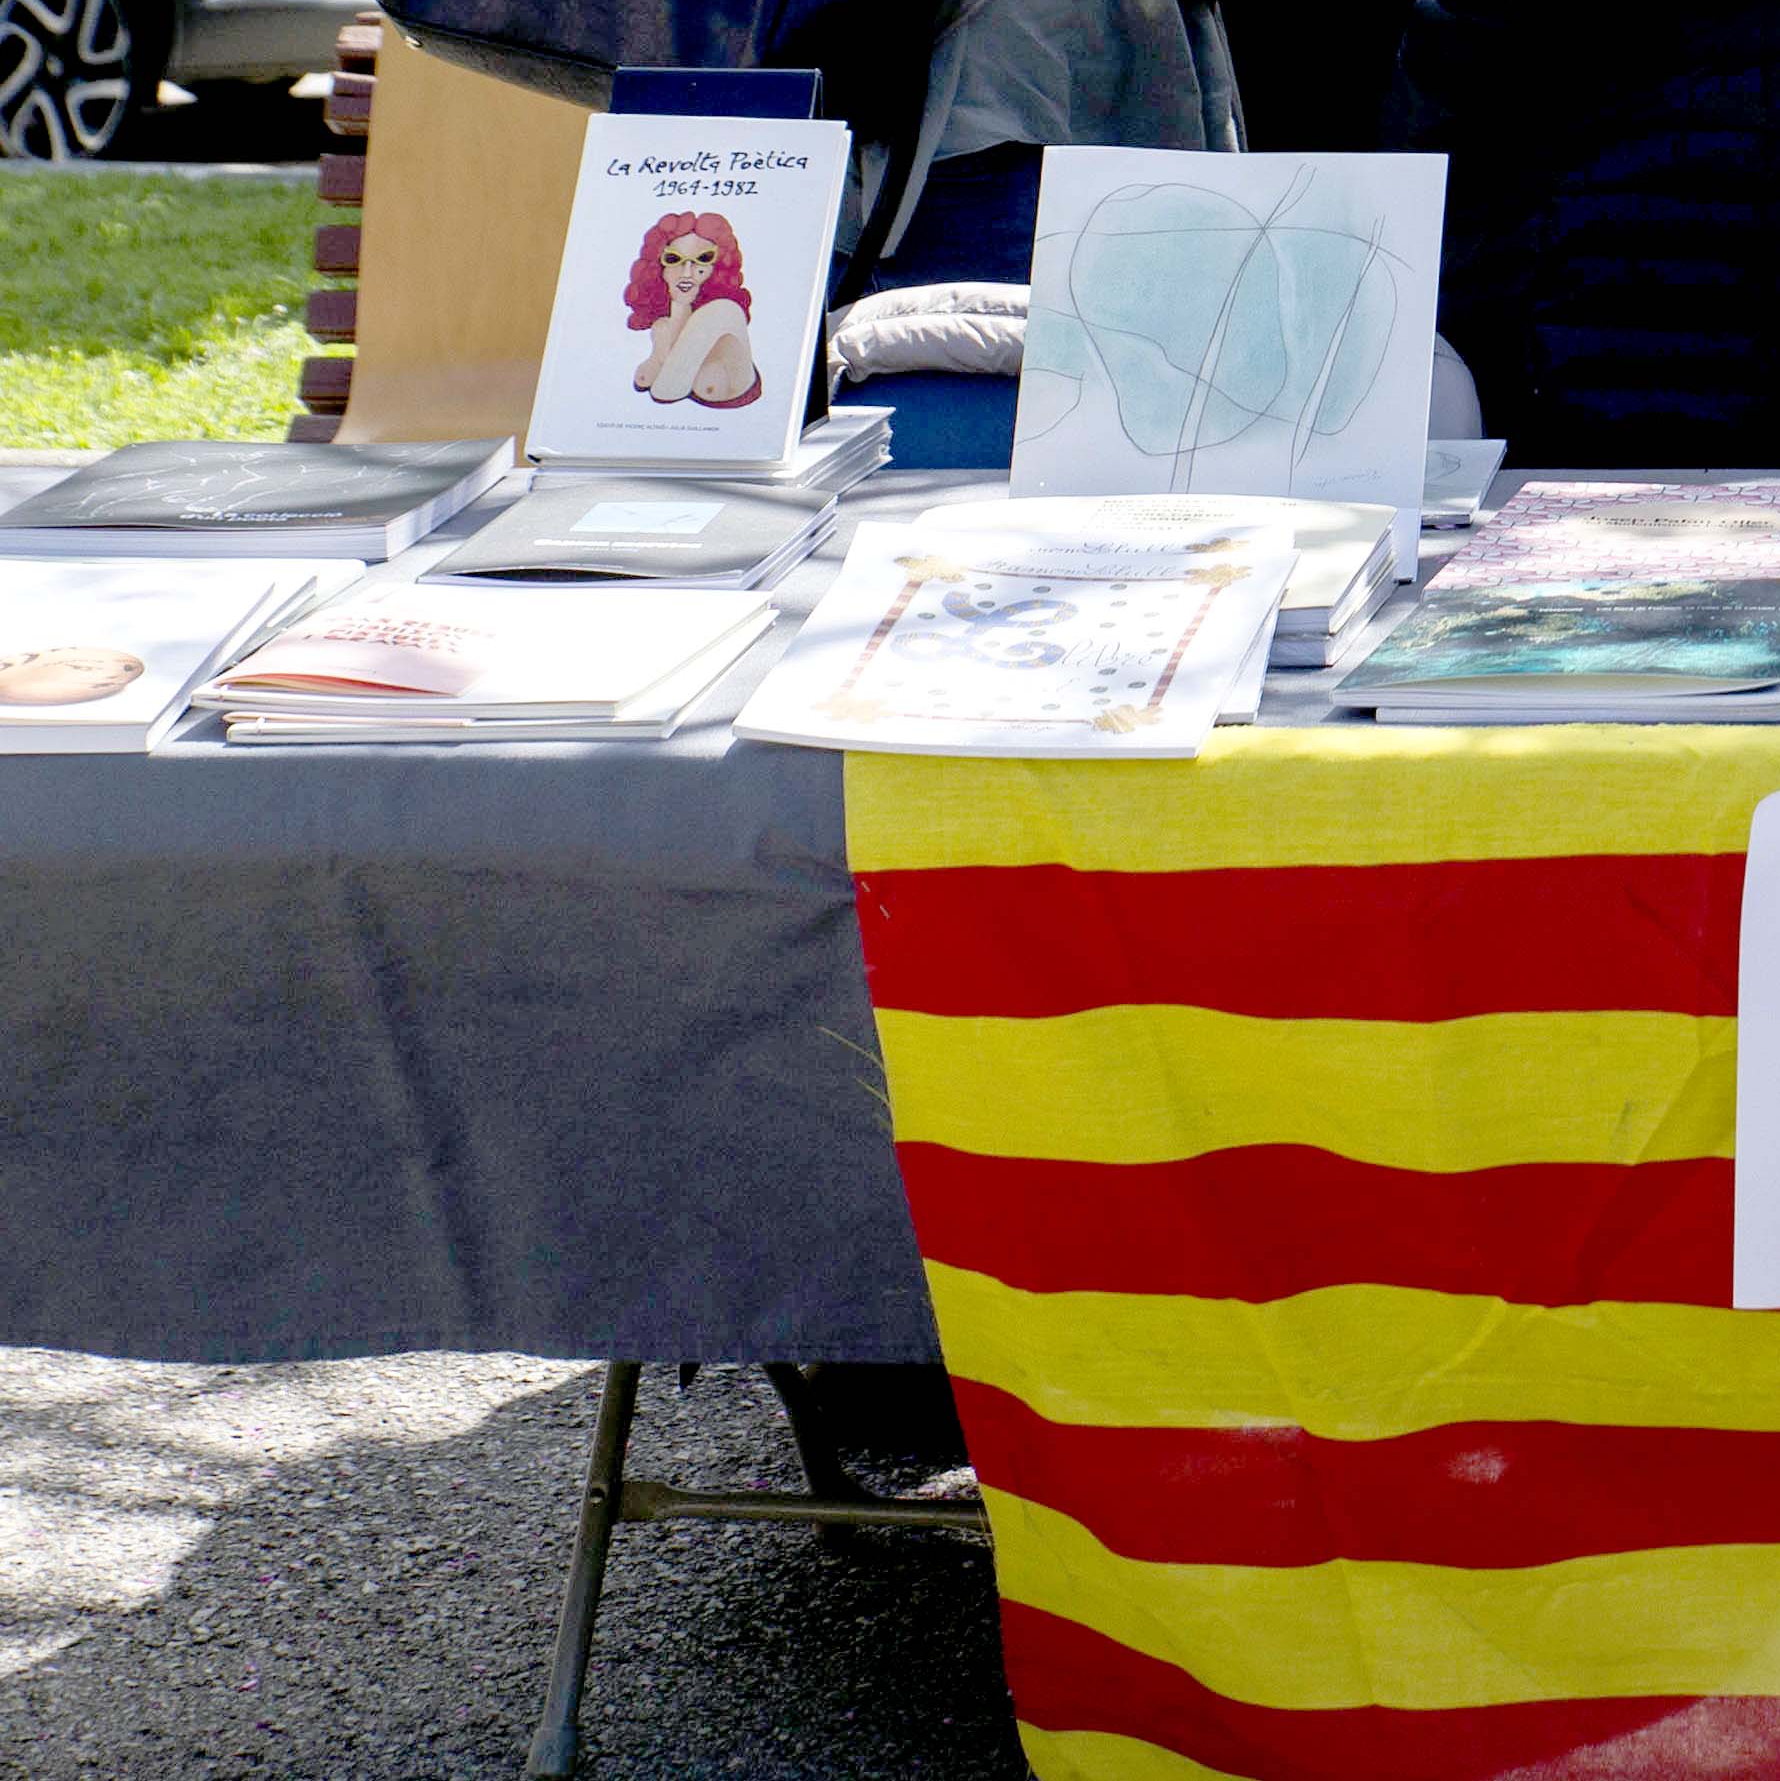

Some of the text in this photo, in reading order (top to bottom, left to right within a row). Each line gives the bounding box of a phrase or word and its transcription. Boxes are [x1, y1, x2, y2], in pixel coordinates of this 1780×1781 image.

[607, 150, 808, 176] La Revolta Poètica
